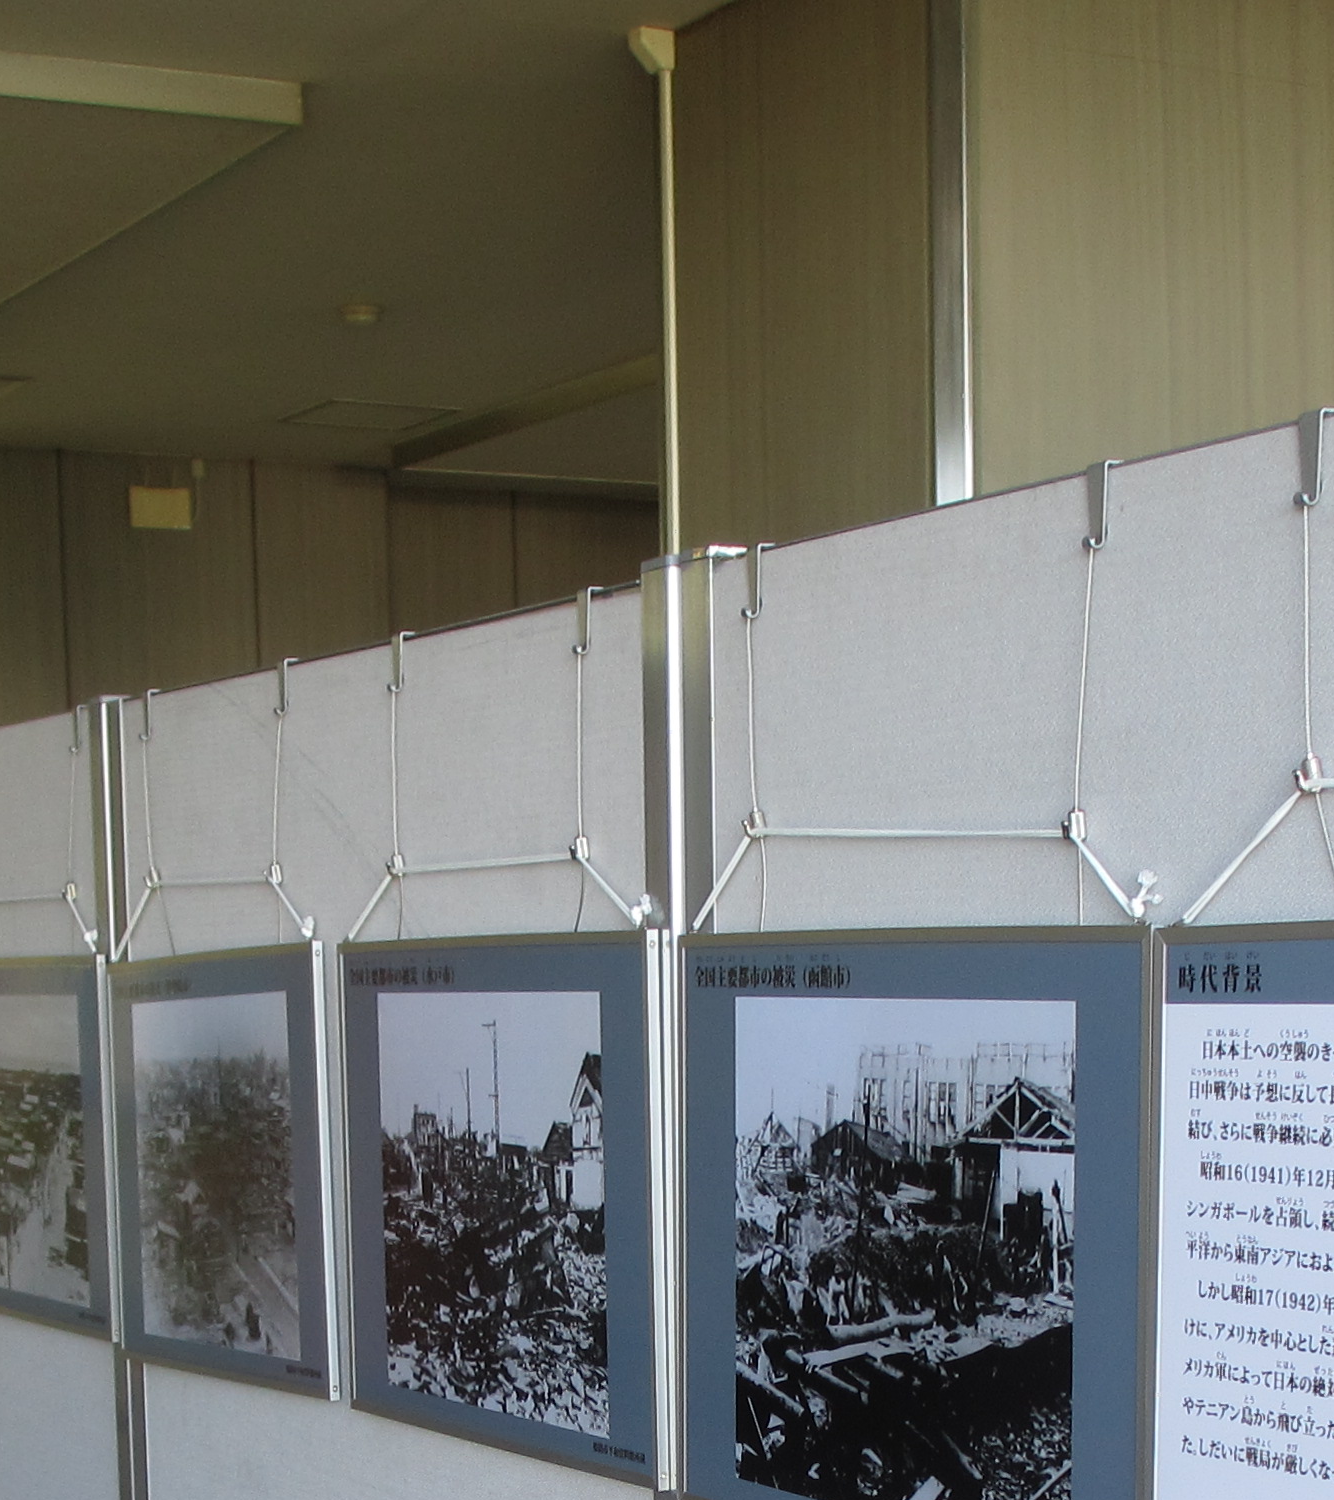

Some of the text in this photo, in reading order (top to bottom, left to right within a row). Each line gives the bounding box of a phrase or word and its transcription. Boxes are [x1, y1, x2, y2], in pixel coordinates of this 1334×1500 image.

[1178, 963, 1263, 994] 時代背景
[1199, 1149, 1224, 1162] しょうわ
[1234, 1271, 1259, 1285] しょうわ
